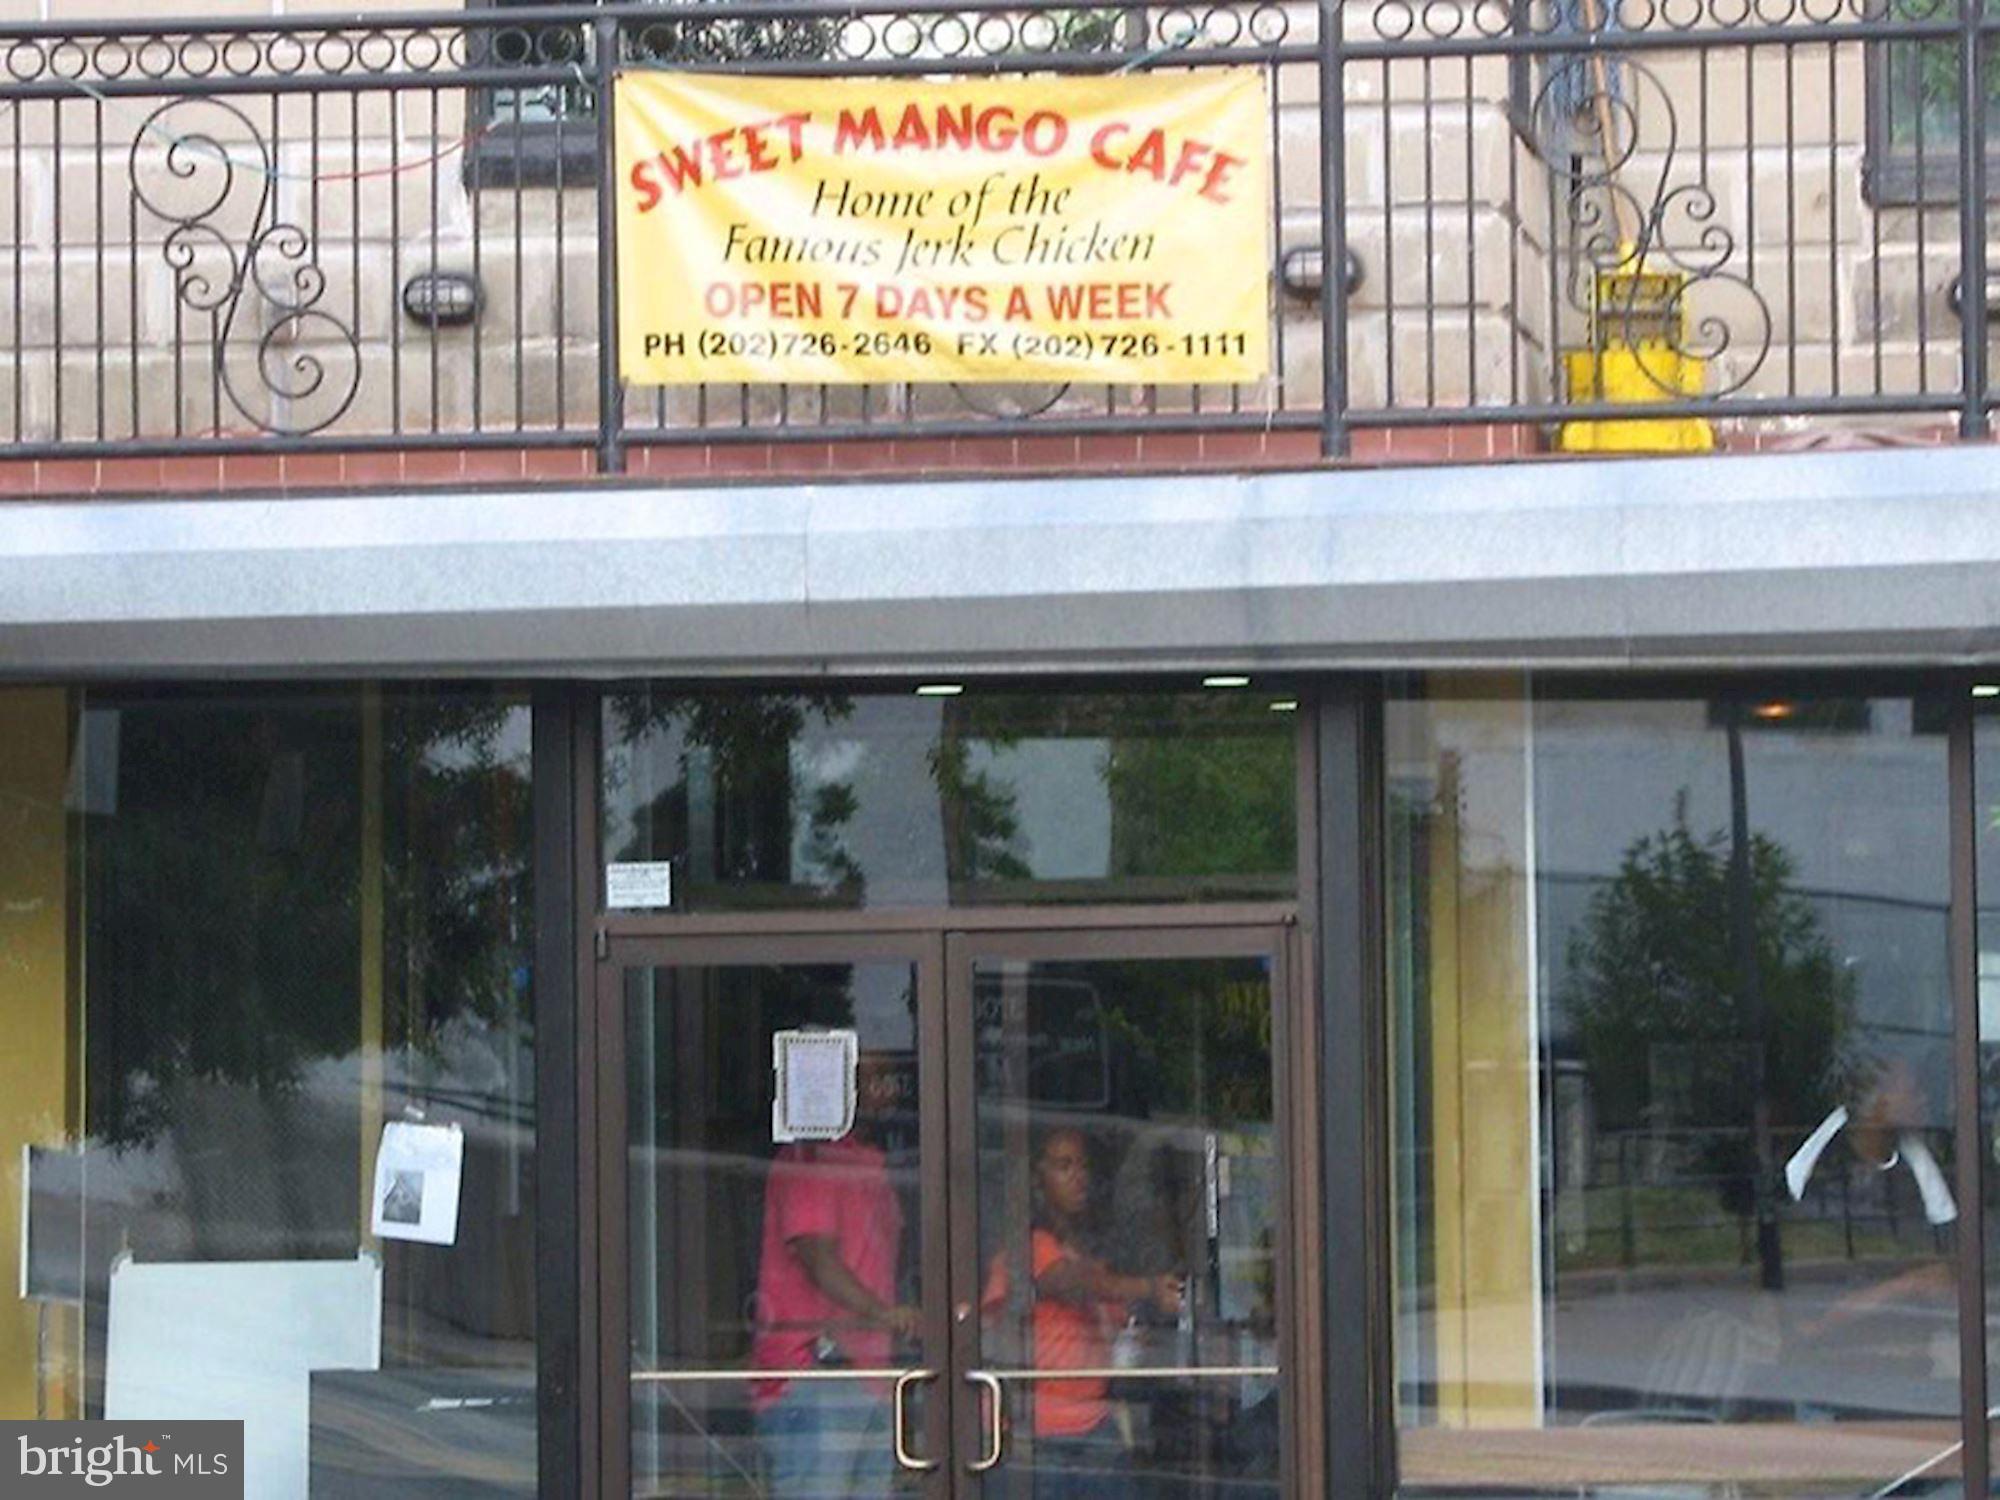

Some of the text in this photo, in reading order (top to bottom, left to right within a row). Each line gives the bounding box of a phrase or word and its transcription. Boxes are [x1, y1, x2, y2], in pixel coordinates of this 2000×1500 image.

[630, 102, 1248, 214] SWEET MANGO CAFE
[810, 172, 1071, 226] Home of the
[722, 220, 1155, 275] Famous Jerk Chicken
[704, 281, 1174, 322] OPEN 7 DAYS A WEEK
[643, 332, 685, 357] PH
[698, 330, 933, 360] (202)726-2646
[956, 331, 999, 356] FX
